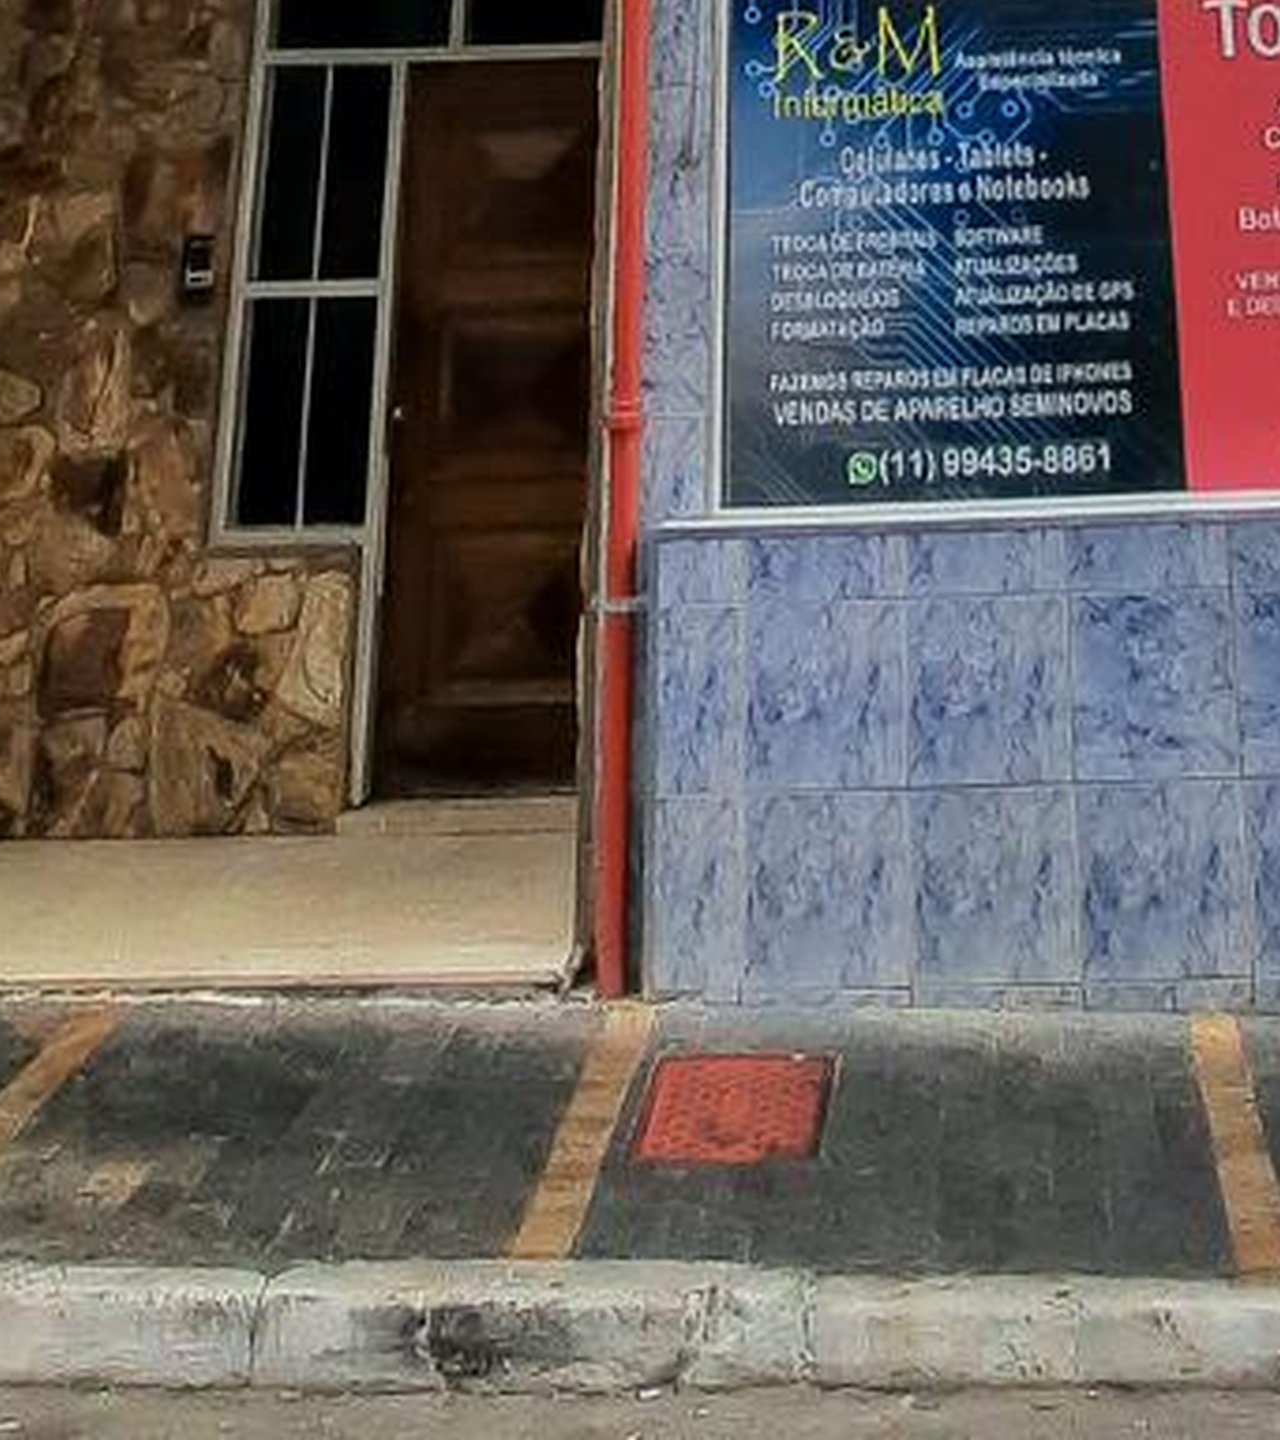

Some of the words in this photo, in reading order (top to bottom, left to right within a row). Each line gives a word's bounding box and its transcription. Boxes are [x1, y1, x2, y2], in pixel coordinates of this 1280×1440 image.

[975, 171, 1091, 203] Notebooks
[773, 399, 858, 427] VENDAS
[861, 399, 889, 422] DE
[894, 394, 1005, 422] APARELHO
[1010, 389, 1133, 418] SEMINOVOS
[878, 448, 935, 486] (11)
[942, 442, 1112, 477] 99435-8861
